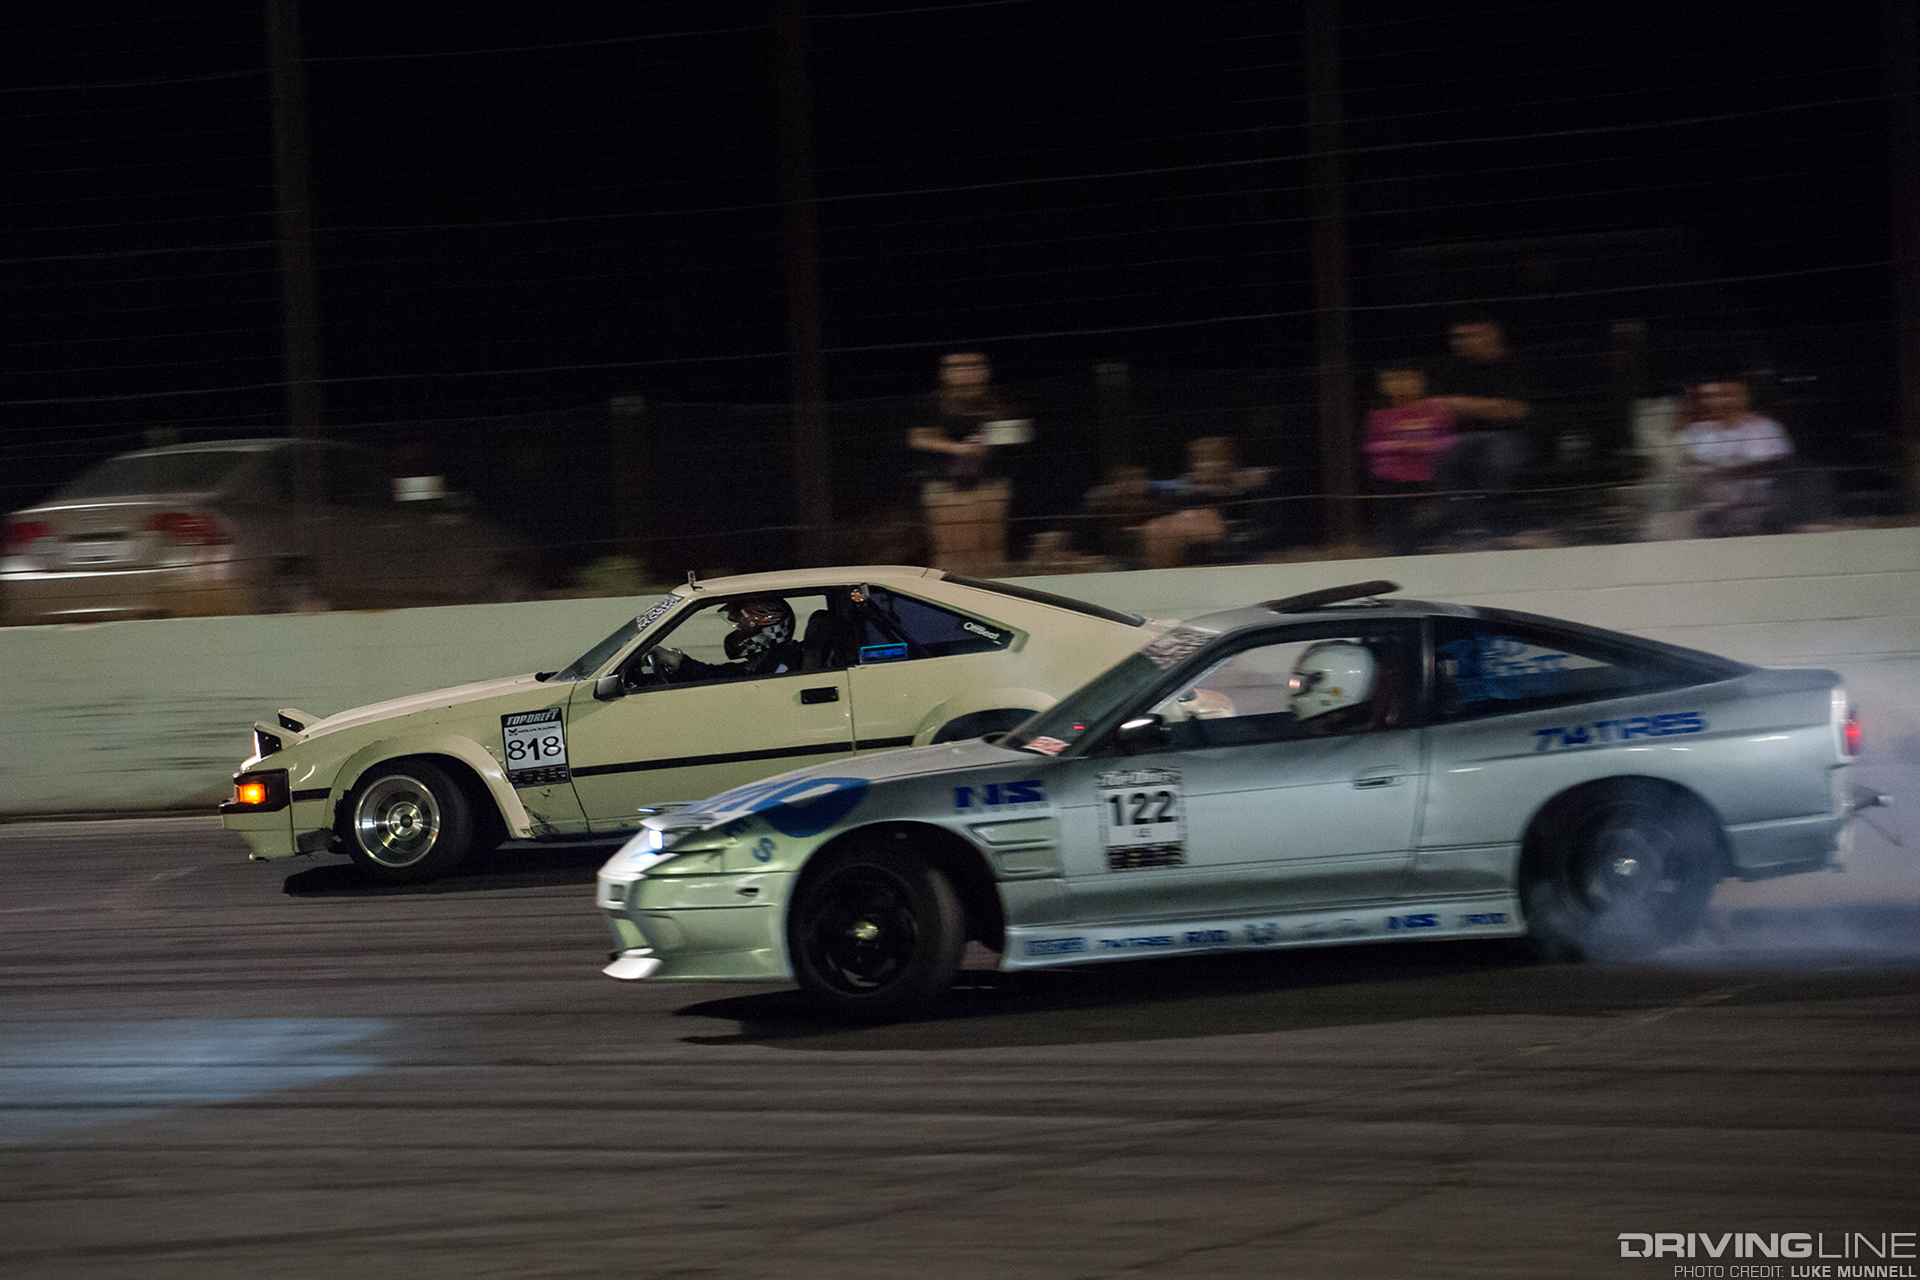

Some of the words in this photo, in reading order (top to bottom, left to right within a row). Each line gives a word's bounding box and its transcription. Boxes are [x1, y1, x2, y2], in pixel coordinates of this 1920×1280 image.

[508, 736, 562, 761] 818
[1107, 790, 1178, 827] 122
[751, 837, 777, 862] S
